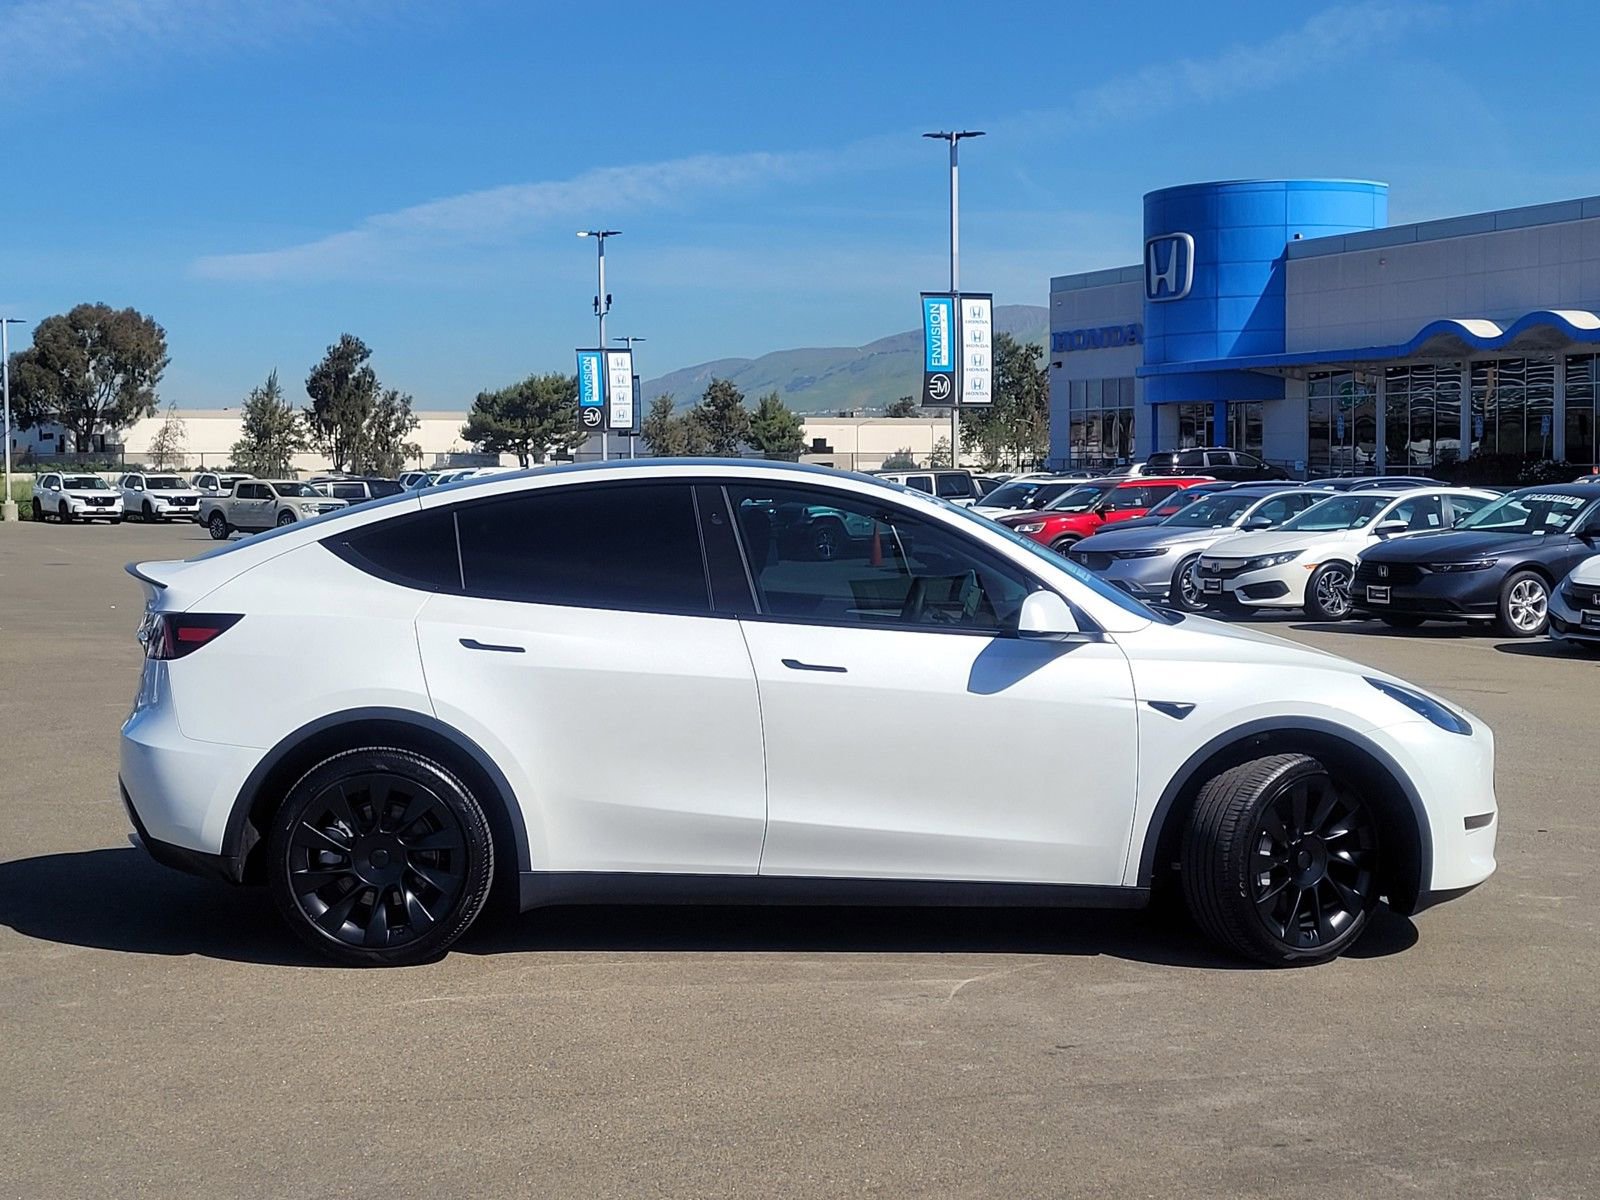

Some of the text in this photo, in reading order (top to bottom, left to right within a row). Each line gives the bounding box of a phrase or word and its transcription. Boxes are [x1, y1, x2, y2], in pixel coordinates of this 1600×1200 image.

[930, 303, 942, 366] ENVISION
[1052, 324, 1144, 353] HONDA
[582, 356, 593, 402] ENVISION
